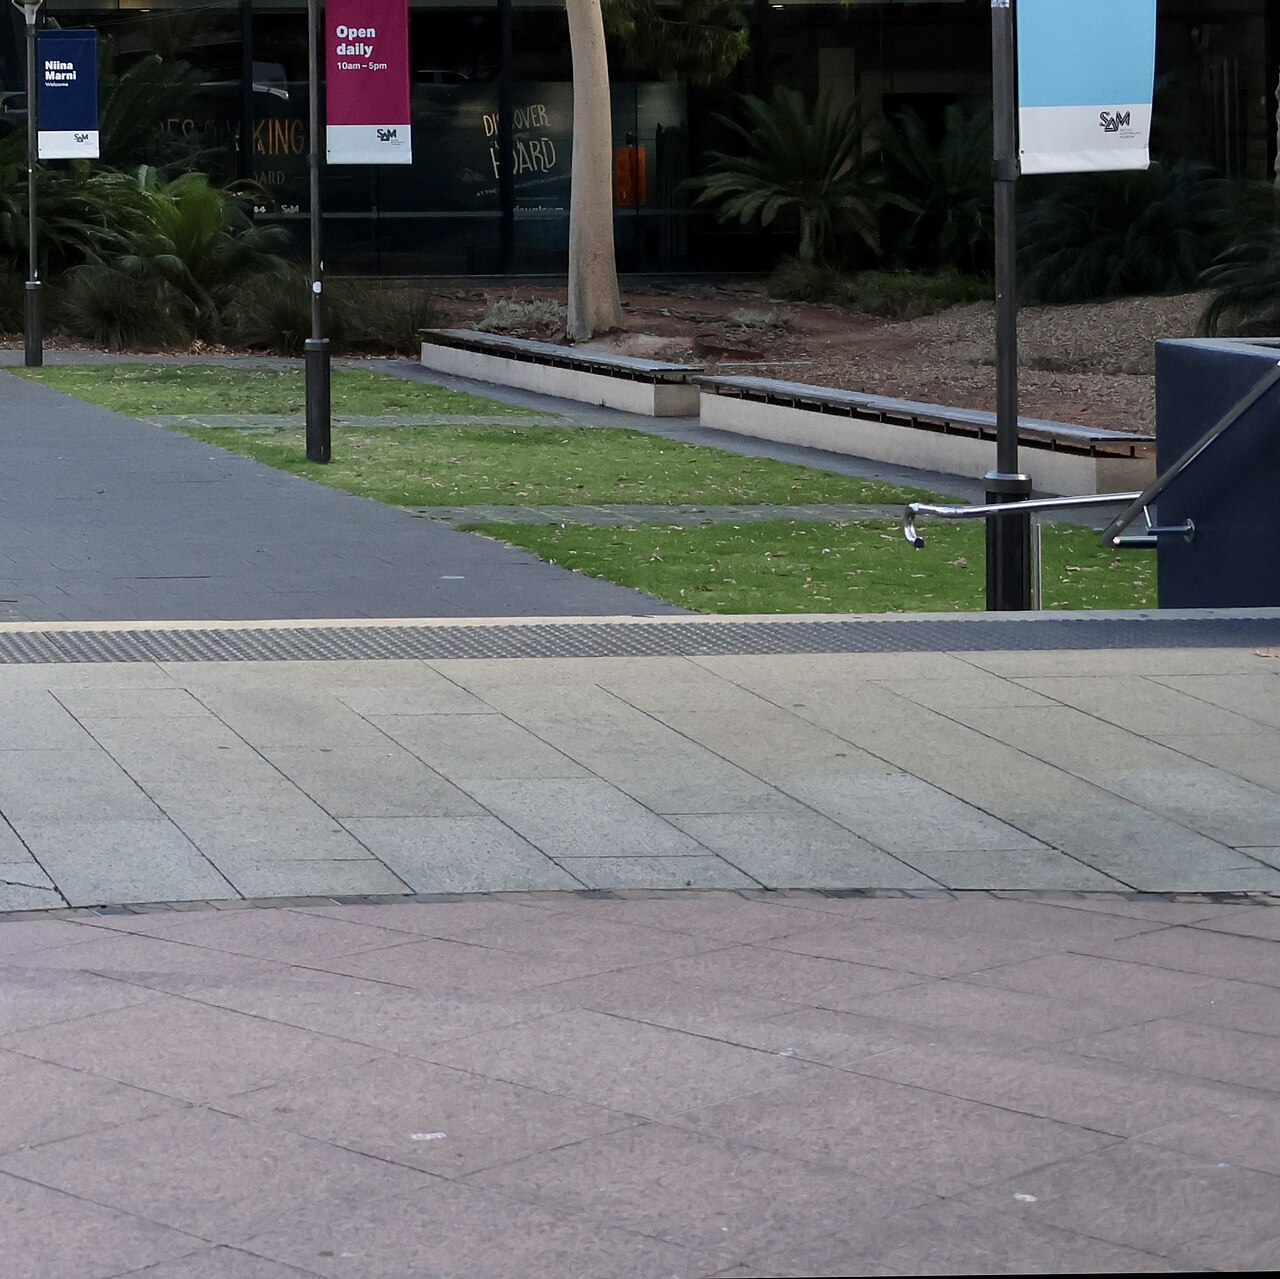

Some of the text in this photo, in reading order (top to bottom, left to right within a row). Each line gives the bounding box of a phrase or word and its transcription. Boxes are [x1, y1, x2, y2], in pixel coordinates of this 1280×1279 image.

[336, 25, 376, 40] Open
[336, 43, 373, 58] daily
[45, 60, 74, 70] Niina
[337, 62, 361, 70] 10am
[368, 62, 387, 71] 5pm
[45, 70, 77, 80] Marni
[482, 105, 552, 137] DIOVER
[227, 119, 304, 155] KING
[253, 170, 285, 185] ARD
